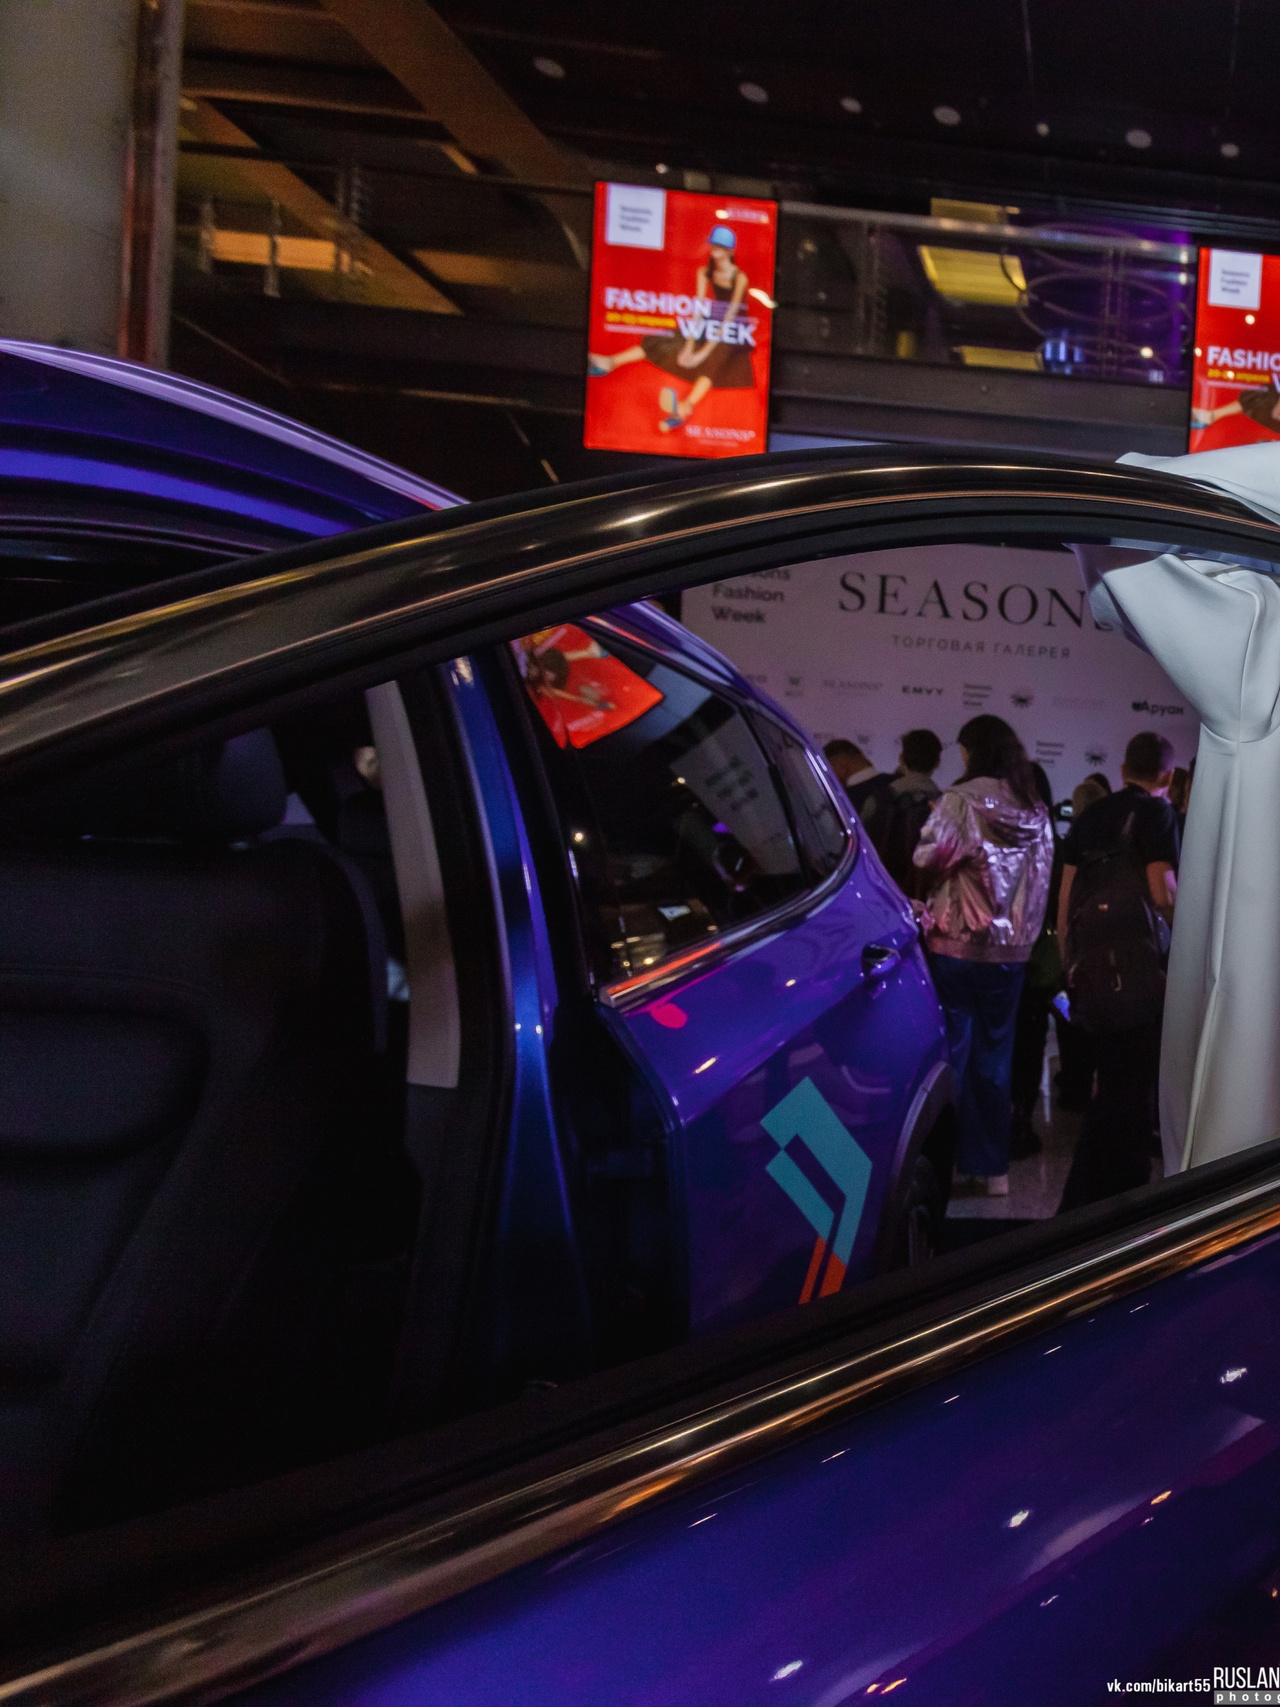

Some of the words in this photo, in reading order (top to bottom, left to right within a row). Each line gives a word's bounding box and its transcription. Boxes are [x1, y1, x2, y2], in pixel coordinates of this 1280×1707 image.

[604, 286, 713, 318] FASHION
[676, 315, 757, 347] WEEK
[712, 583, 785, 602] Fashion
[838, 570, 1115, 632] SEASON
[711, 605, 766, 624] Week
[892, 634, 985, 654] ТОРГОВАЯ
[993, 643, 1071, 659] ГАЛЕРЕЯ
